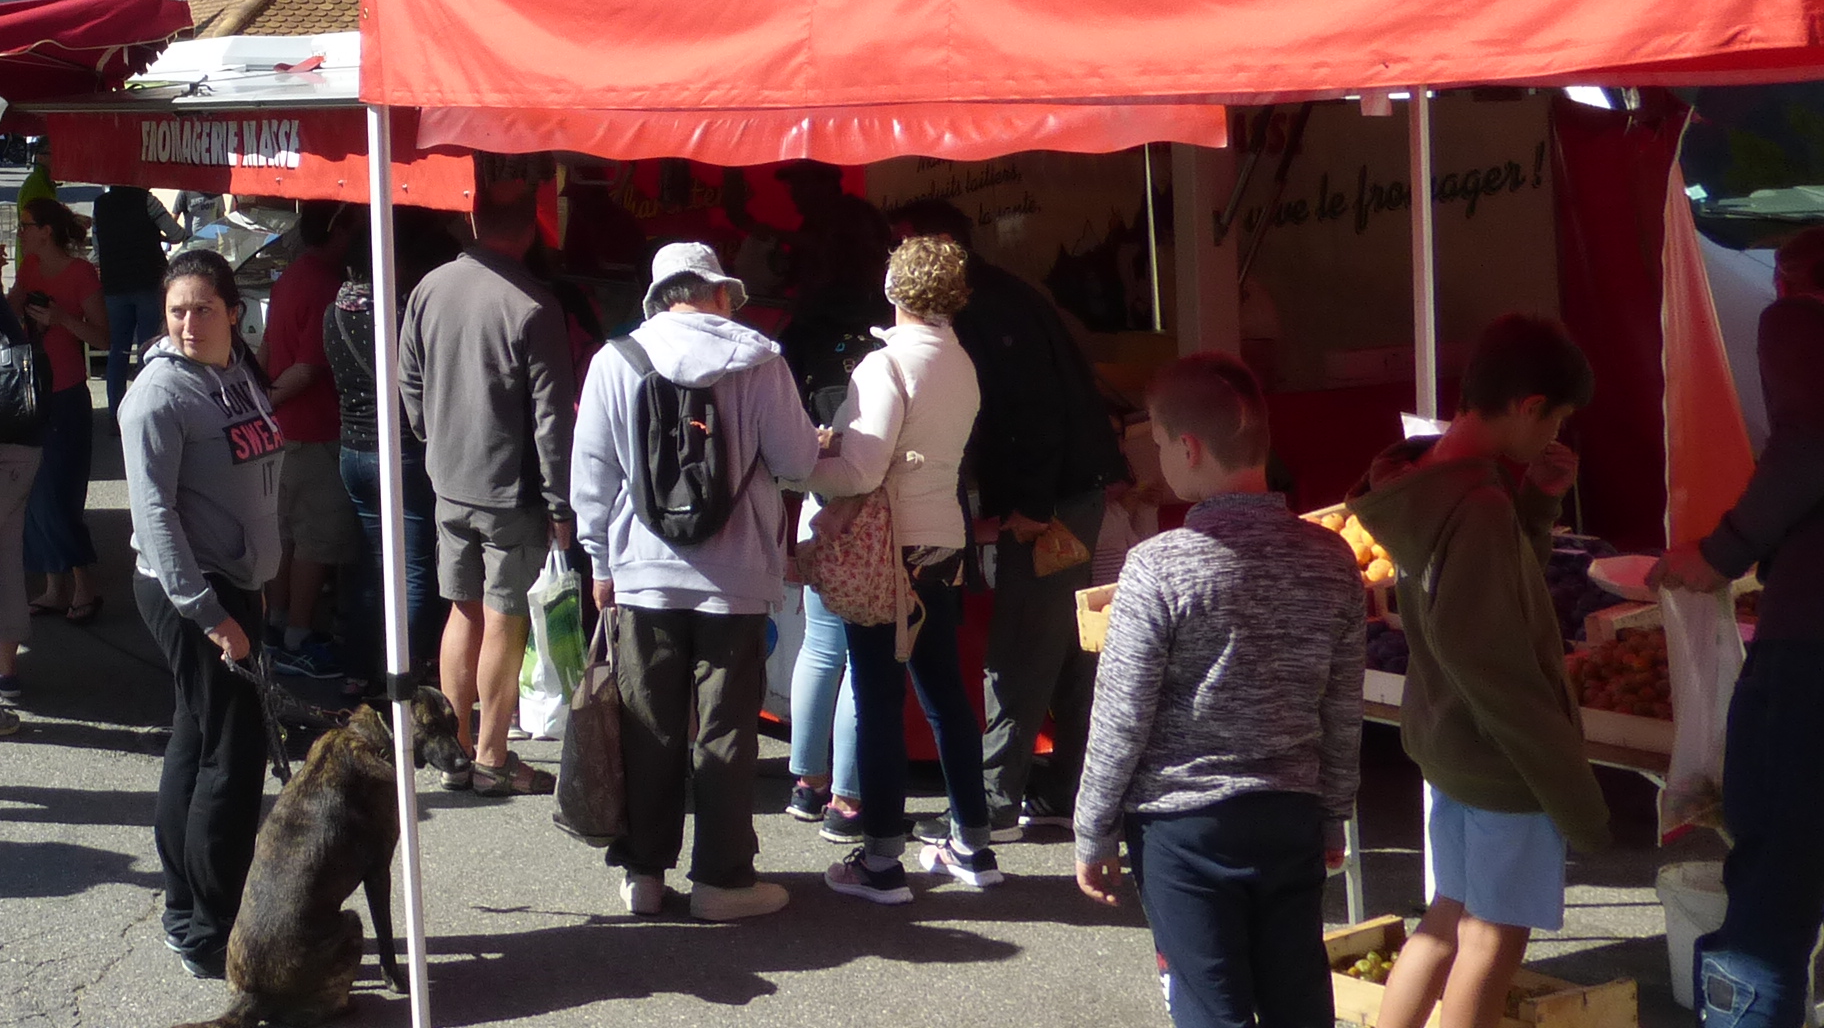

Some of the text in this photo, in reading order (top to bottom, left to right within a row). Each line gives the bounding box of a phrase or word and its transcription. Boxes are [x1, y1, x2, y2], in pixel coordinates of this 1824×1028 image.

[142, 118, 301, 168] FROMAGERIE MASSE
[906, 175, 963, 209] oduits
[1317, 172, 1348, 220] le
[262, 459, 275, 496] IT
